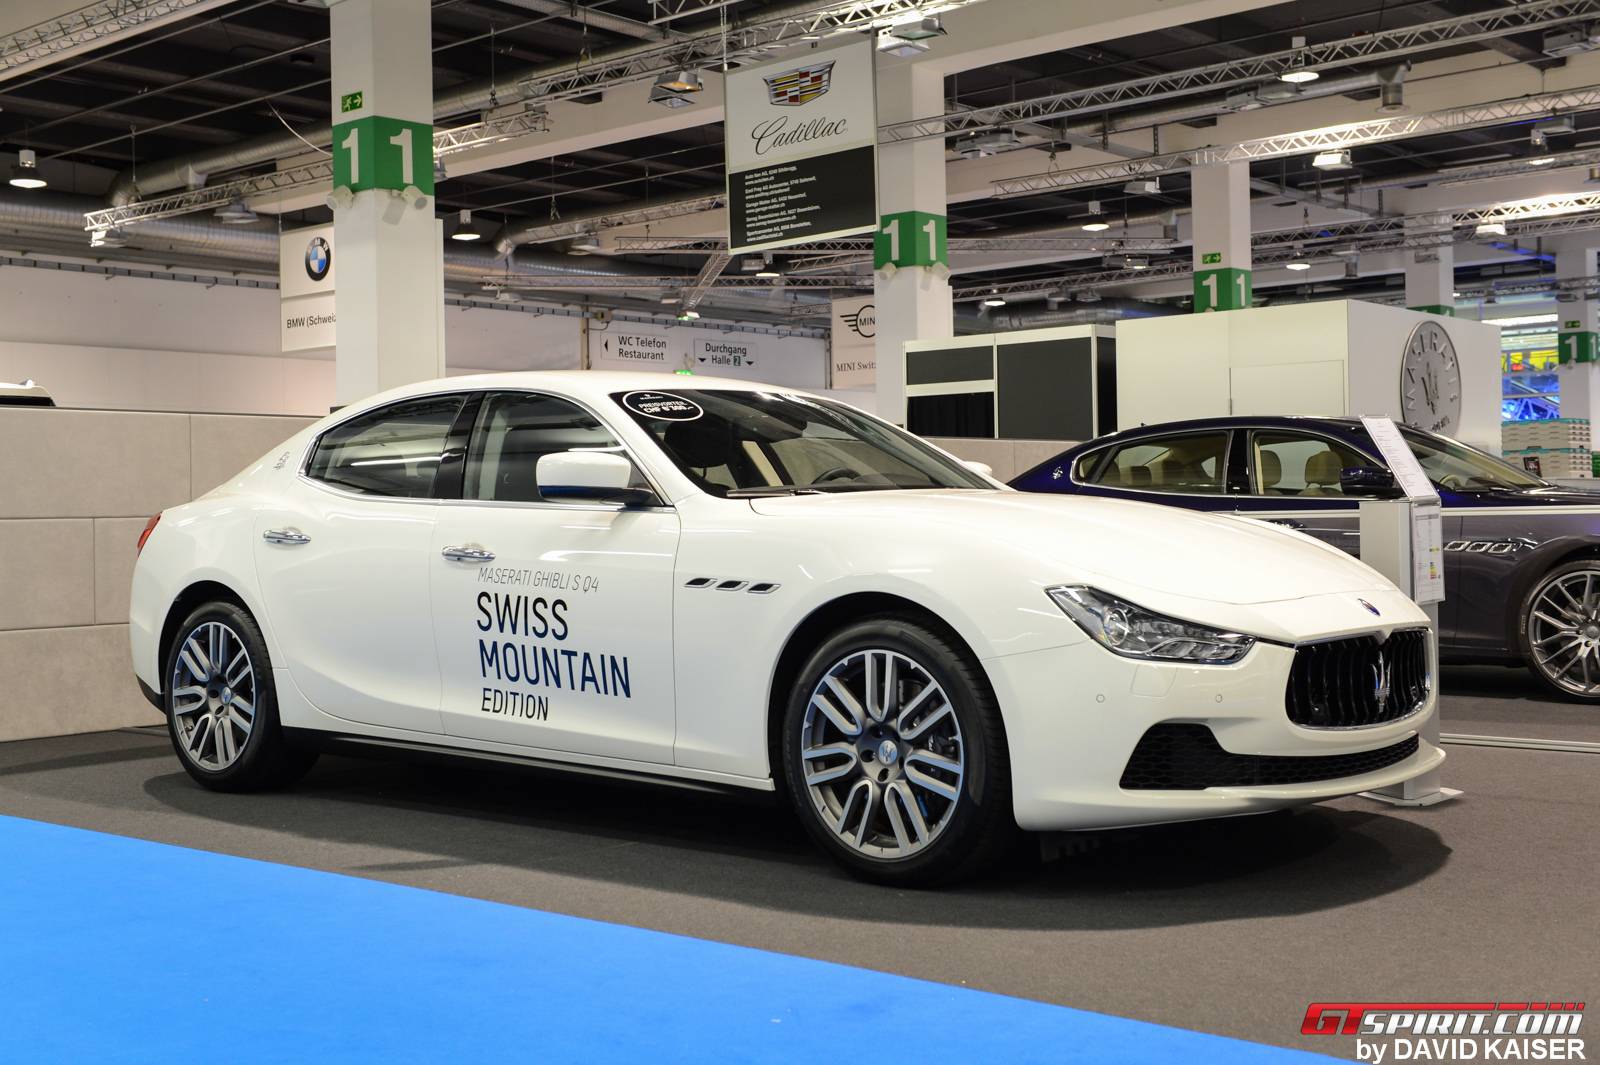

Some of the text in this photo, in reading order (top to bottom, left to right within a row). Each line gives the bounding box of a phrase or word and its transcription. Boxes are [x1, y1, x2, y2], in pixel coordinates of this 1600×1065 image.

[751, 115, 847, 155] Cadillac
[342, 128, 359, 184] 1
[390, 128, 413, 184] 1
[883, 219, 899, 261] 1
[923, 220, 936, 261] 1
[1202, 274, 1217, 307] 1
[1236, 274, 1245, 306] 1
[287, 317, 305, 329] BMW
[859, 317, 876, 326] MIN
[618, 335, 667, 348] WC Telefon
[618, 348, 664, 360] Restaurant
[705, 343, 747, 356] Durchgang
[1565, 336, 1577, 359] 1
[1590, 336, 1597, 359] 1
[711, 355, 741, 366] Halle 2
[836, 362, 855, 372] MINI
[477, 567, 600, 593] MASERATI GHIBLI S Q4
[477, 591, 568, 641] SWISS
[479, 639, 632, 698] MOUNTAIN
[481, 687, 549, 721] EDITION
